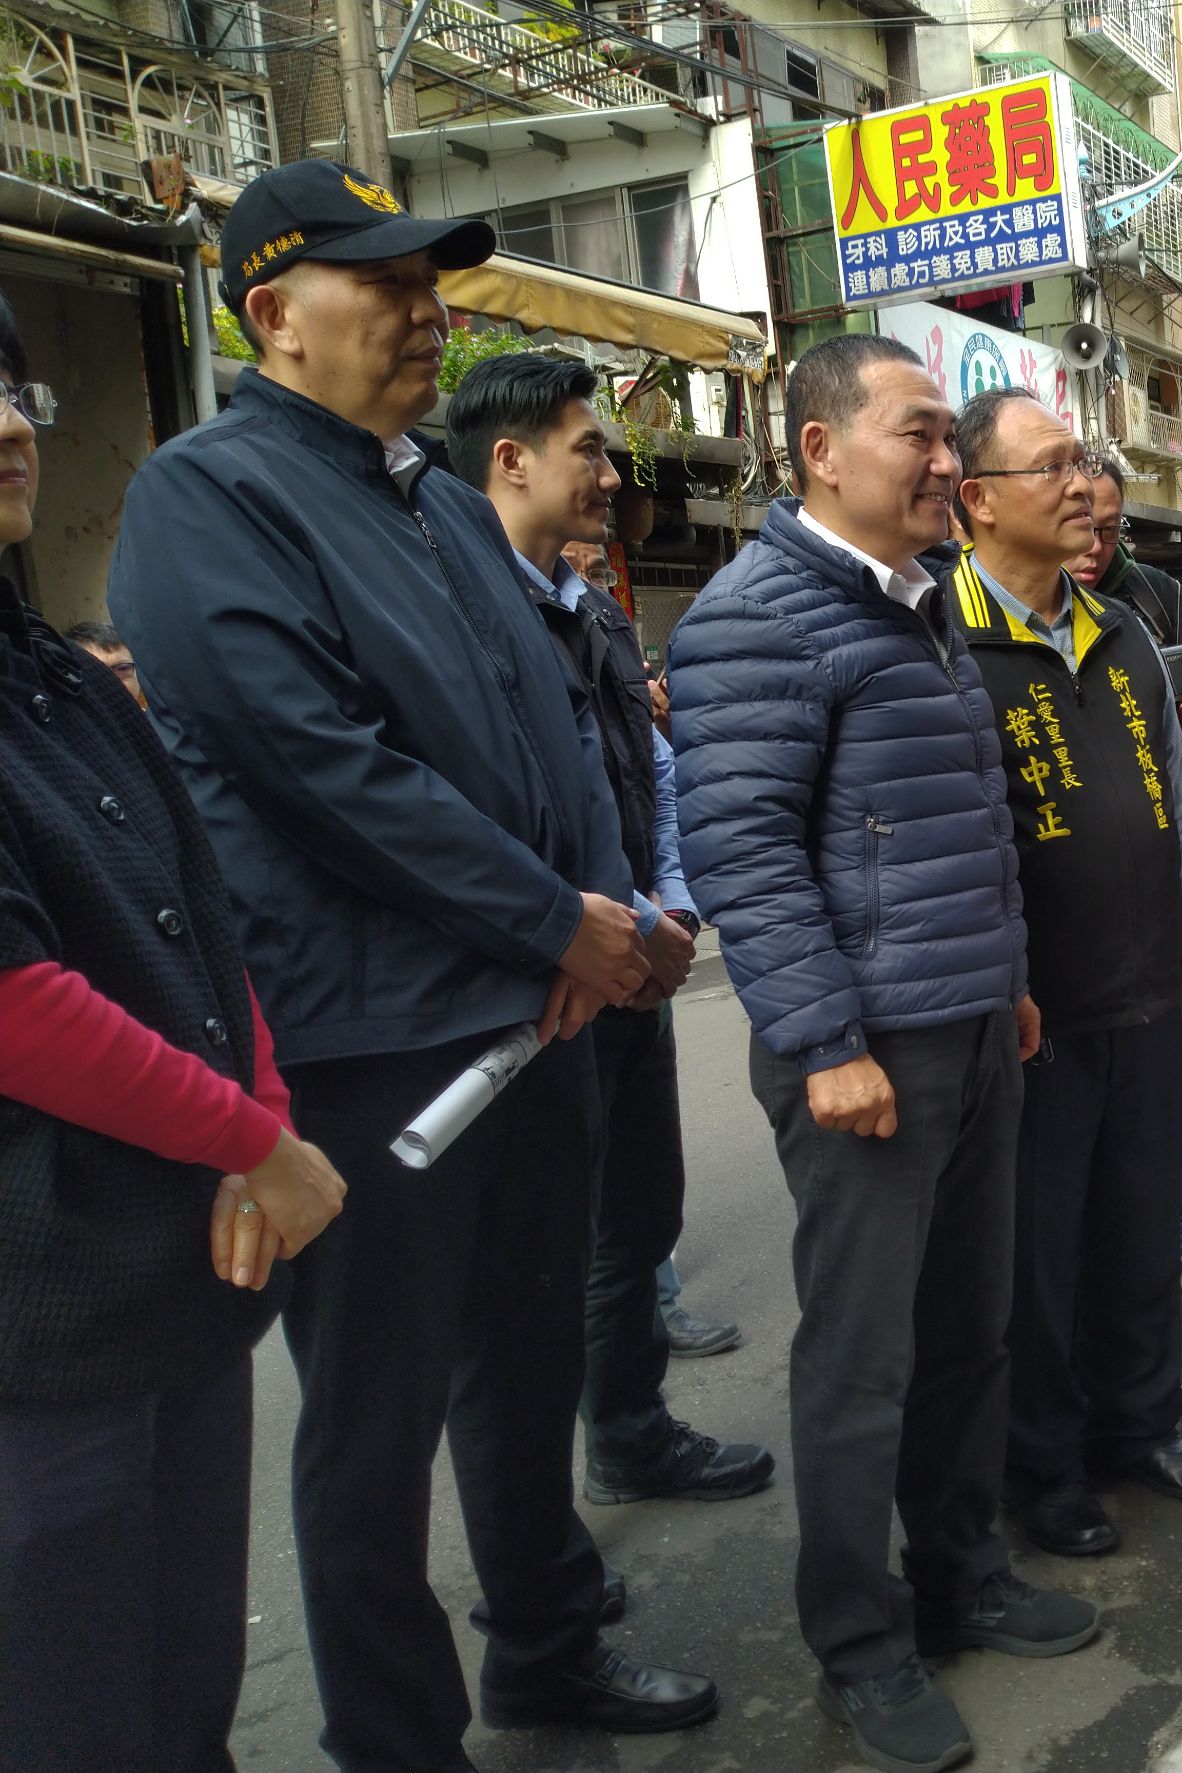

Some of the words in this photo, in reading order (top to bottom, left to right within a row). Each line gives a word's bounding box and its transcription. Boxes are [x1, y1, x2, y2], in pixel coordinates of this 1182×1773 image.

[841, 87, 1055, 231] 人民藥局
[845, 234, 889, 266] 牙科
[897, 200, 1060, 254] 診所及各大醫院
[848, 234, 1063, 297] 連續處方箋免費取藥處
[1005, 707, 1072, 842] 葉中正
[1028, 682, 1084, 791] 仁愛里里長
